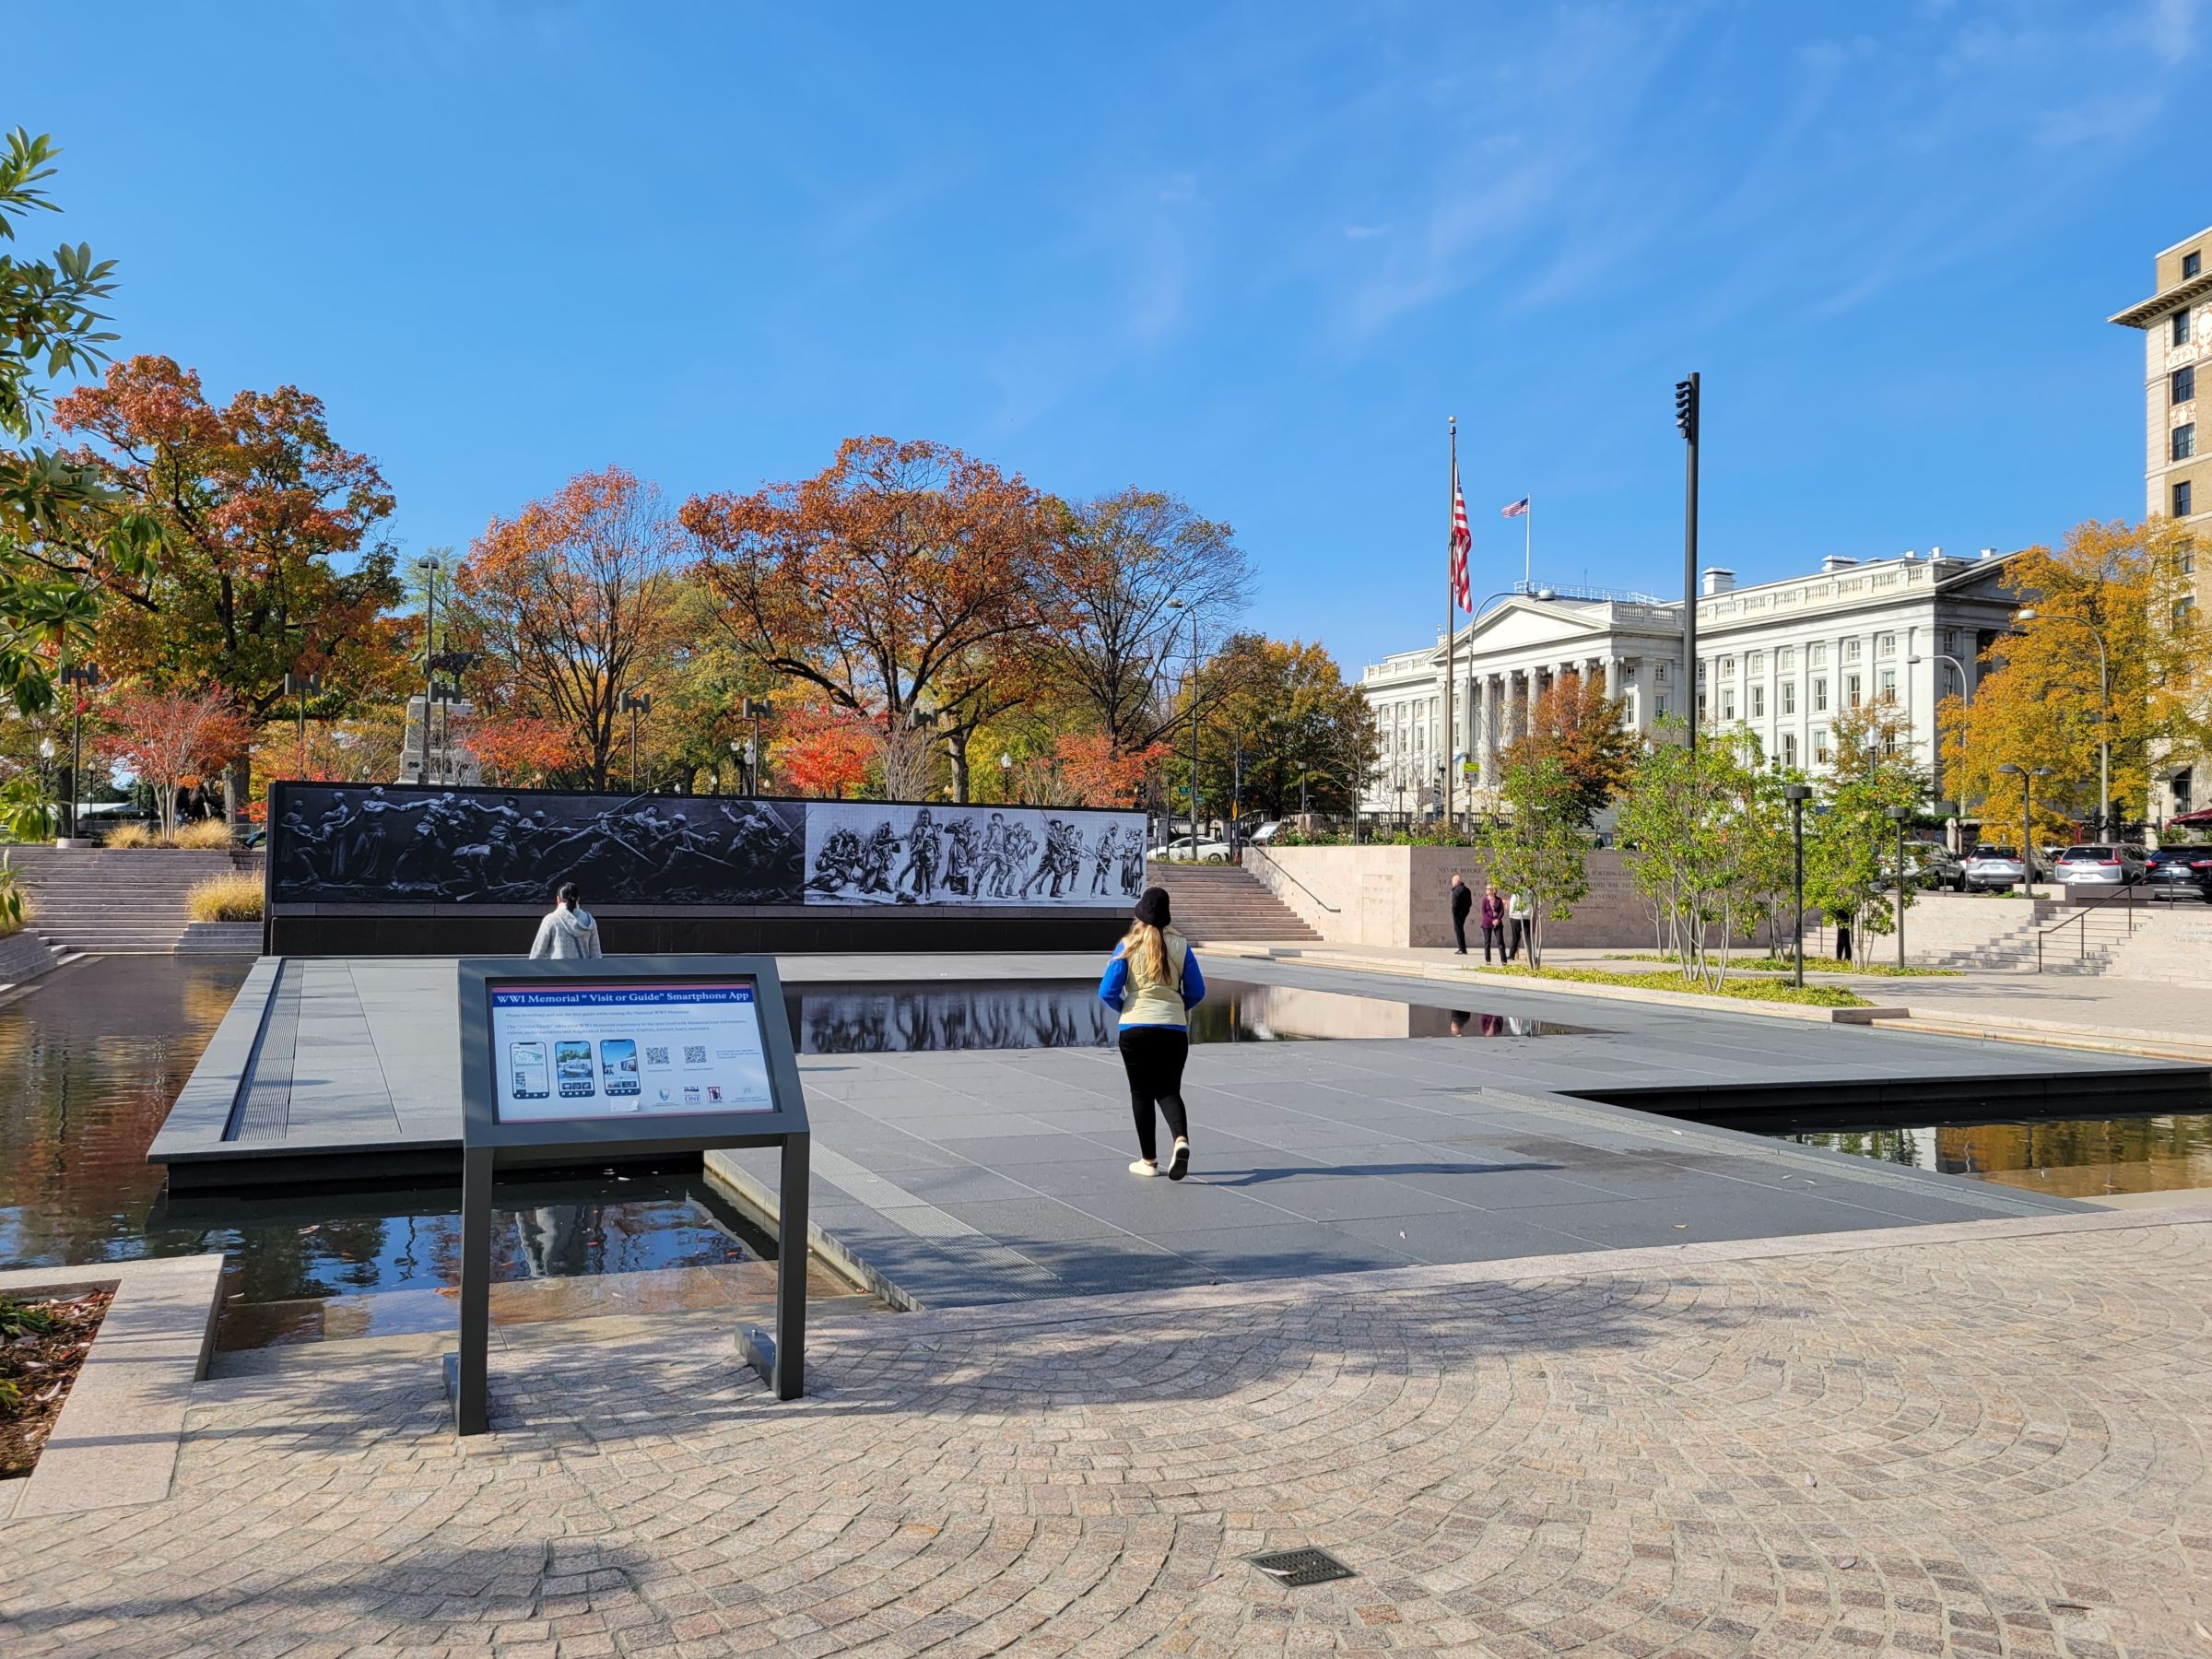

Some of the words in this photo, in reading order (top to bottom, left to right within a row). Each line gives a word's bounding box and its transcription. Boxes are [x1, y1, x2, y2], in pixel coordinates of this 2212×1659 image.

[497, 994, 525, 1004] WWI
[528, 994, 580, 1003] Memorial
[589, 994, 613, 1002] Visit
[666, 992, 726, 1001] Smartphone
[729, 991, 749, 1001] App
